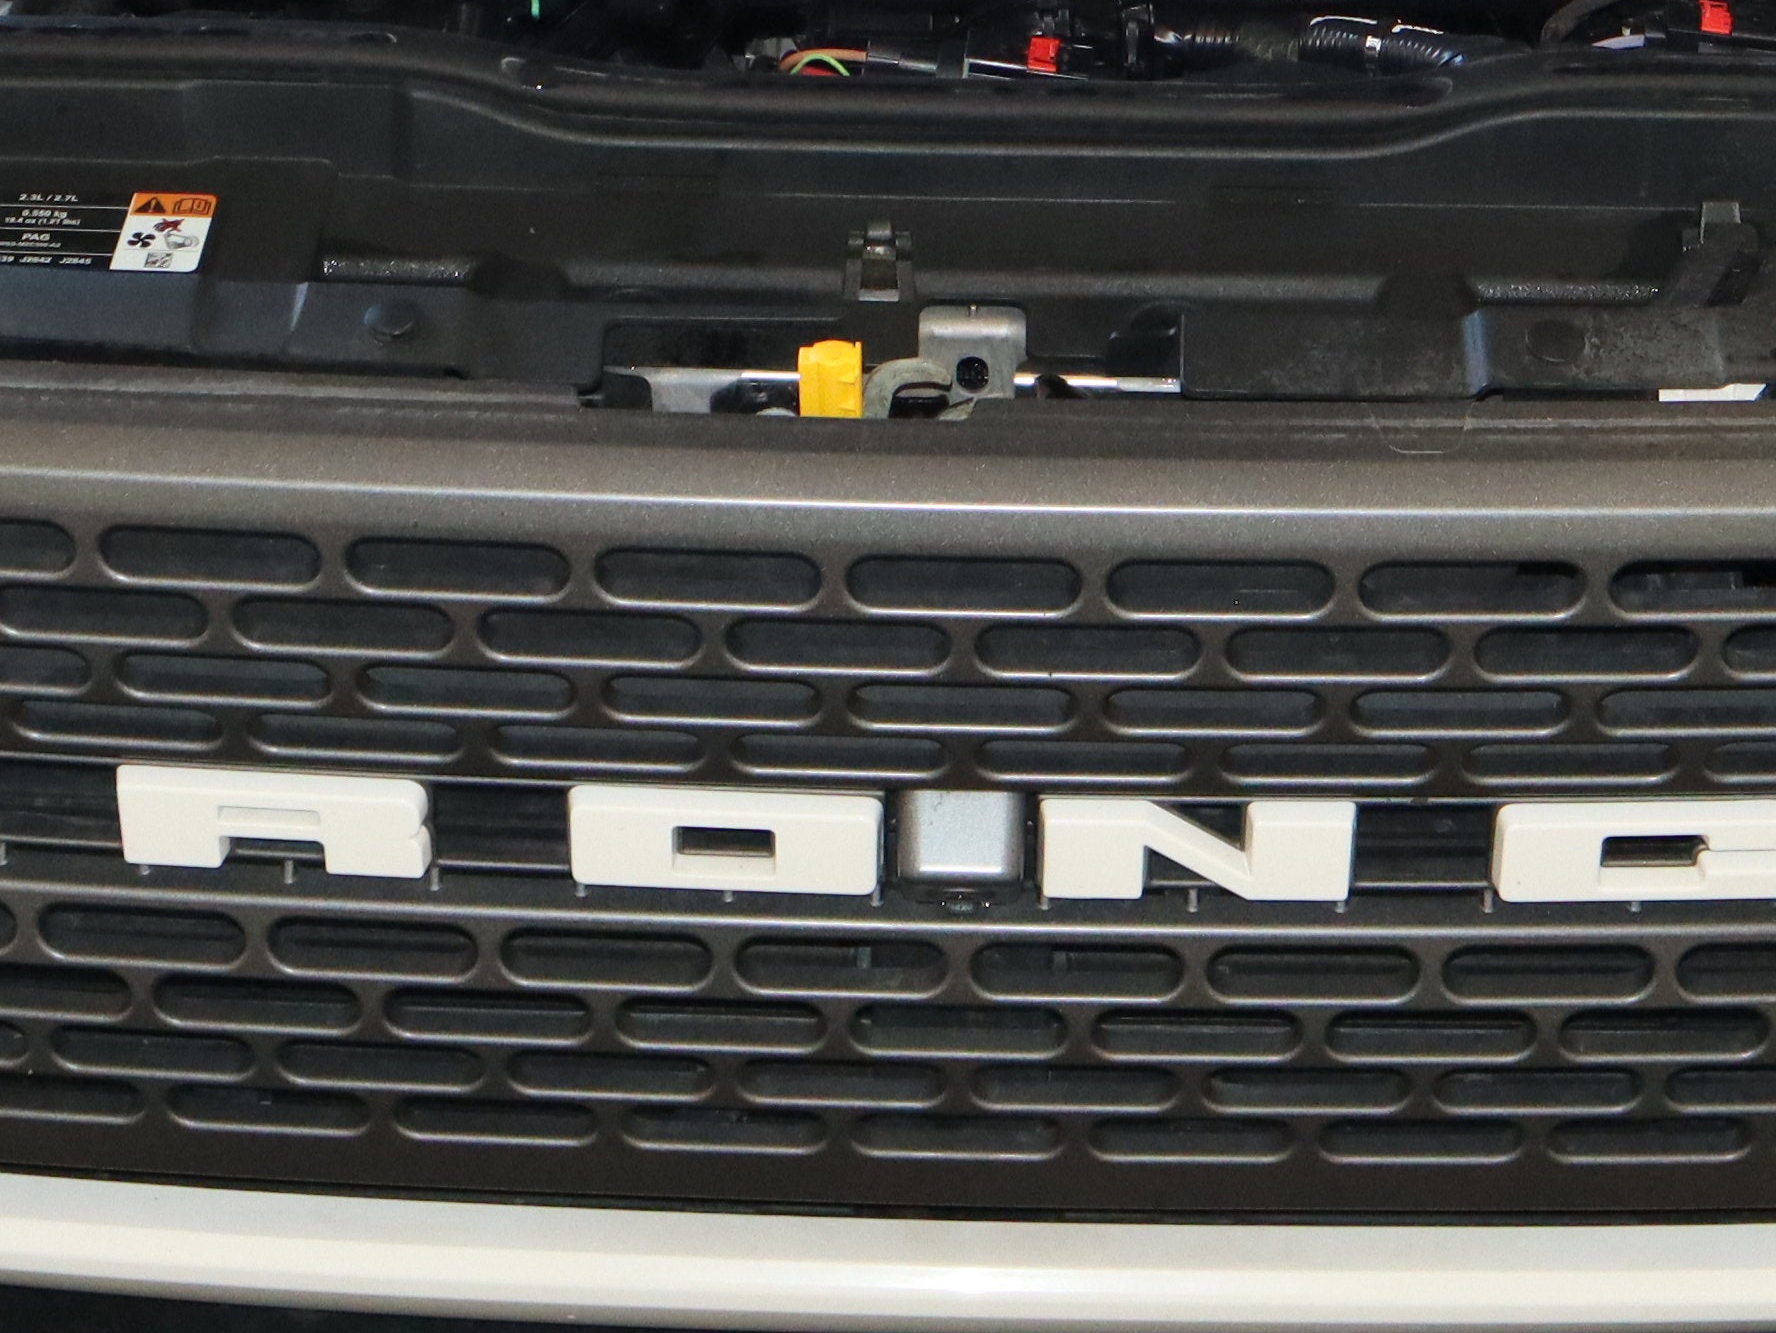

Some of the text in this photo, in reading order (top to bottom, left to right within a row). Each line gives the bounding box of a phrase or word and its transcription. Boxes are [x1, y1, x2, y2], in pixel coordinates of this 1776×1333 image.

[18, 193, 43, 202] 2.3L
[53, 194, 79, 202] 2.7L
[21, 233, 51, 241] PAG
